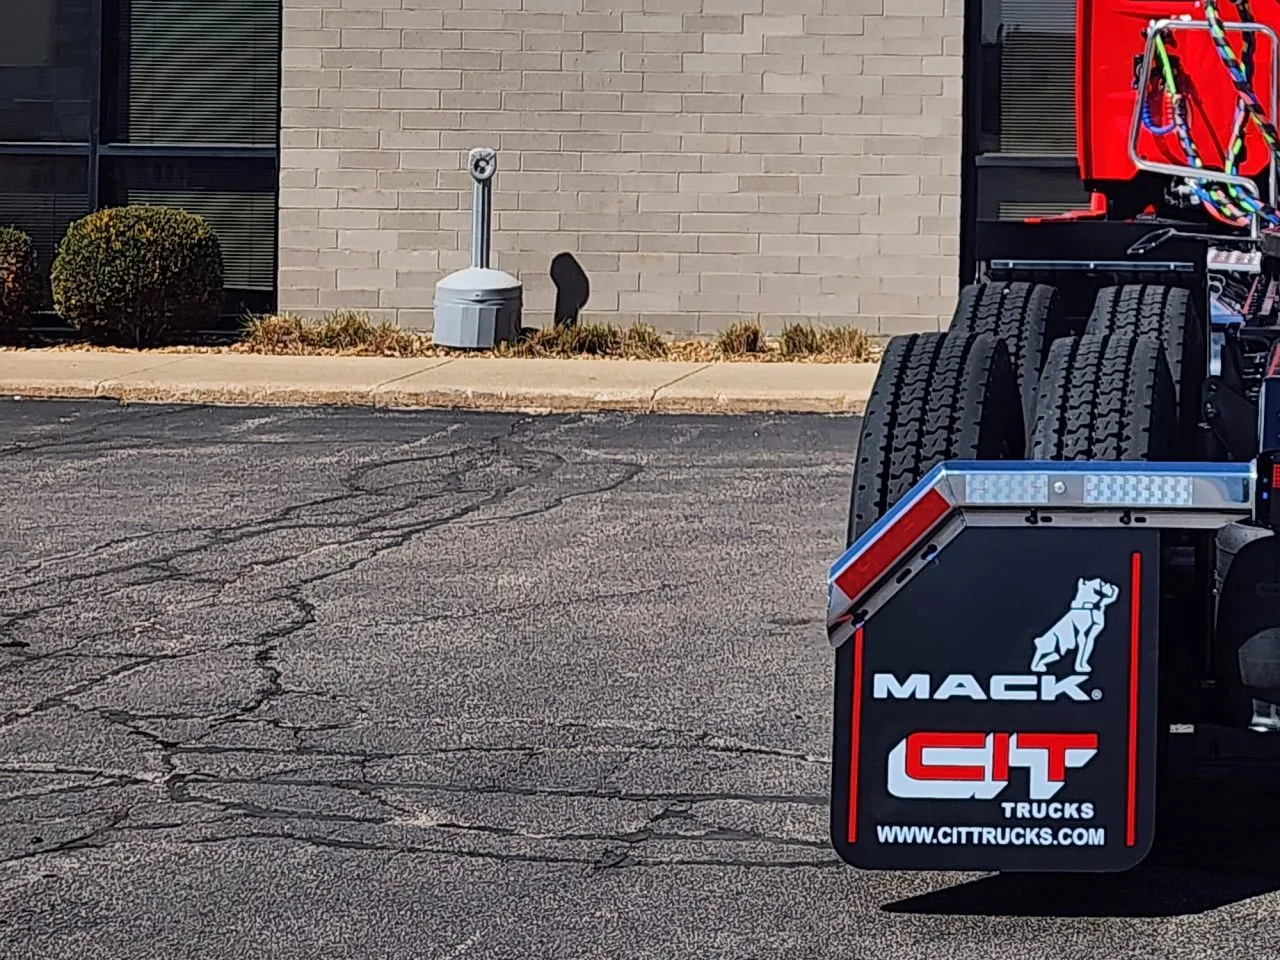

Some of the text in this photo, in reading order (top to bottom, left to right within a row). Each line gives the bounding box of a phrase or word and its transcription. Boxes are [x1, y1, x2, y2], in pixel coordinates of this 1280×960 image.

[905, 732, 1098, 782] CIT
[1001, 801, 1094, 819] TRUCKS
[876, 825, 1105, 846] WWW.CITTRUCKS.COM
